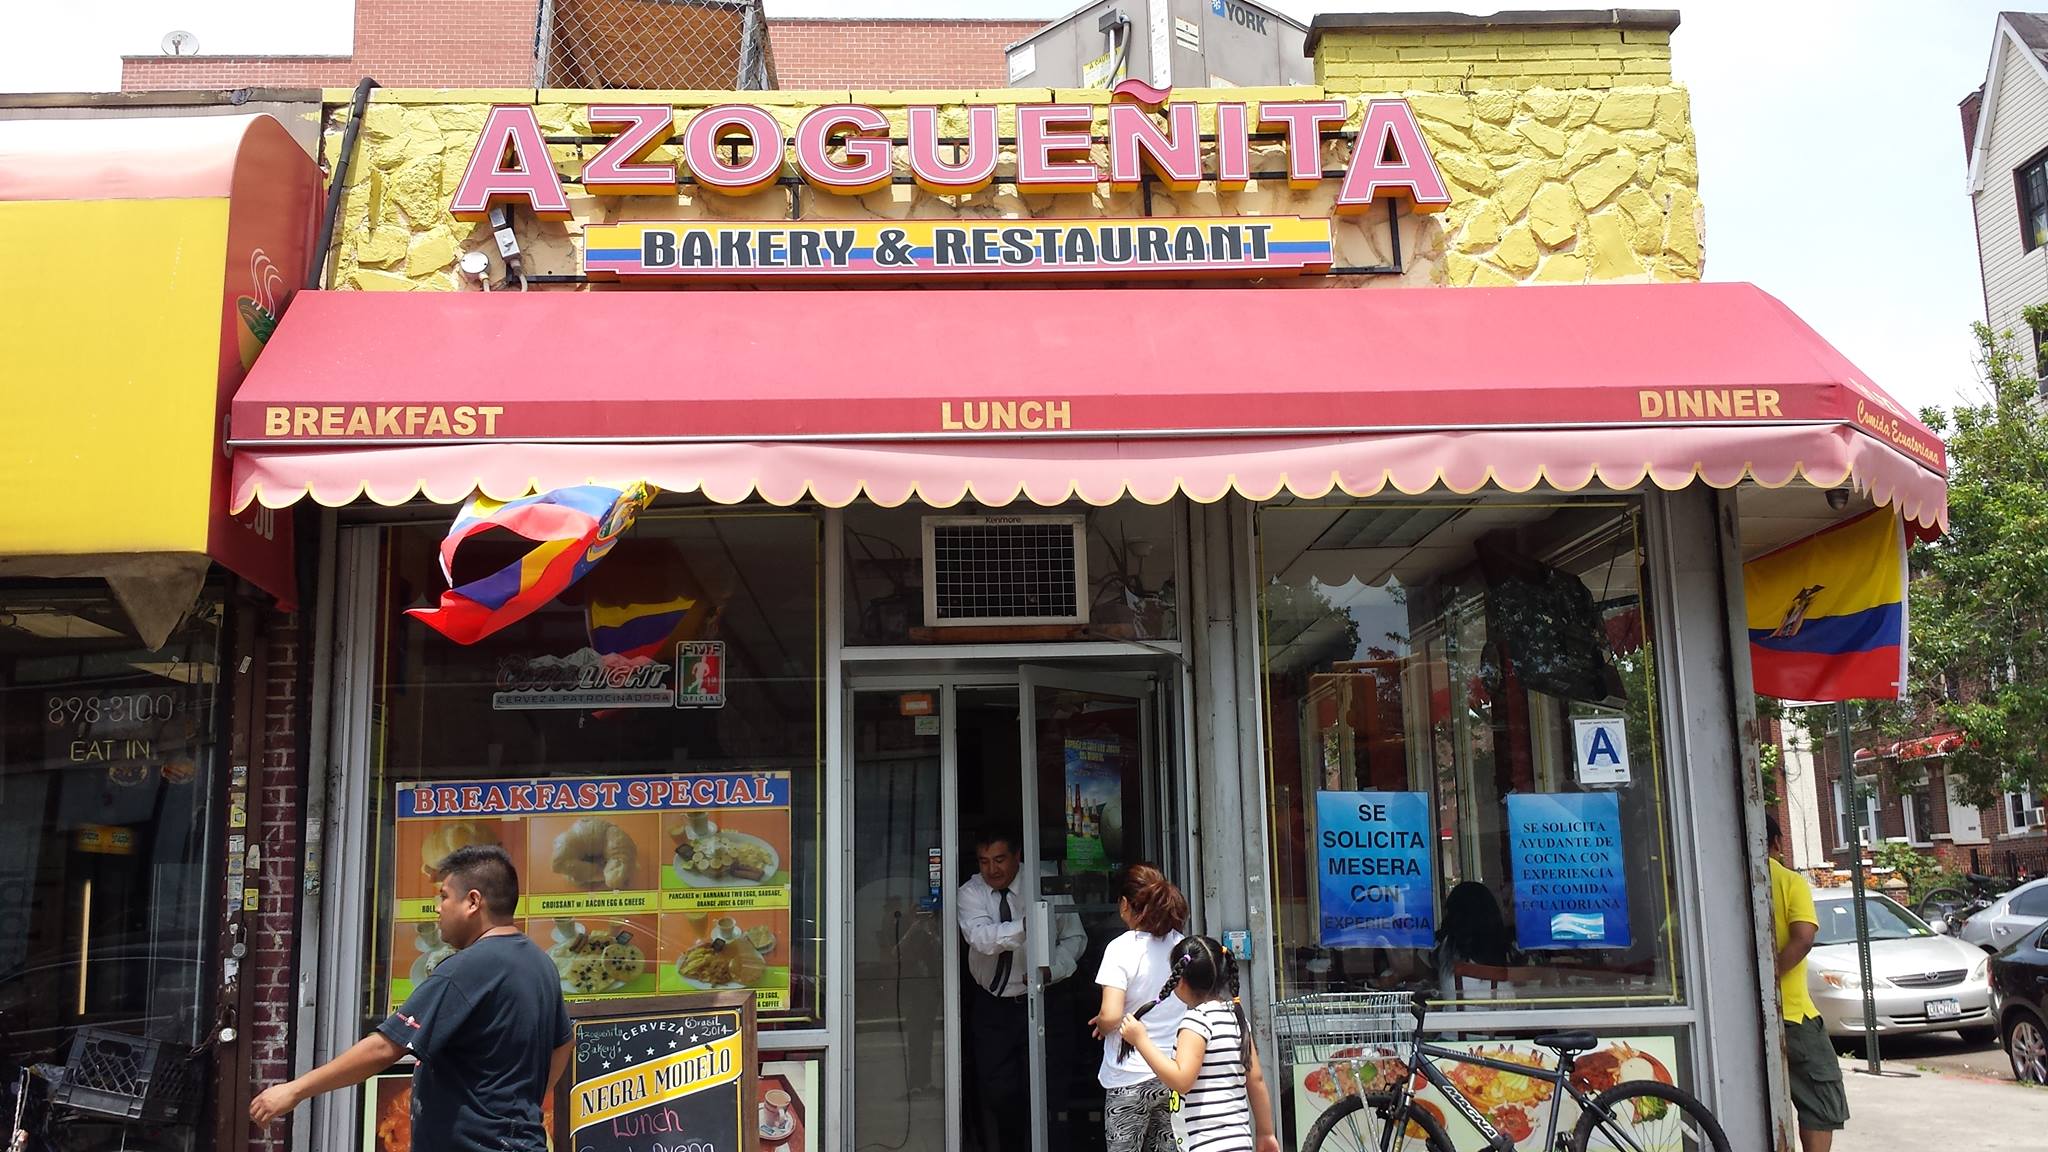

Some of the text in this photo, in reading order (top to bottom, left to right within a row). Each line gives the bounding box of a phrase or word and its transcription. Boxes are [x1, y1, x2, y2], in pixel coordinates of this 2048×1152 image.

[1225, 1, 1267, 35] YORK
[450, 79, 1452, 216] AZOGUEÑITA
[641, 225, 1272, 269] BAKERY & RESTAURANT
[265, 389, 1783, 436] BREAKFAST LUNCH DINNER
[1857, 399, 1940, 465] Comida Ecuatoriana
[985, 516, 1022, 524] Kenmore
[579, 663, 672, 688] LIGHT
[682, 695, 721, 703] OFICIAL
[49, 694, 173, 724] 898-3100
[71, 740, 151, 761] EAT IN
[1587, 727, 1620, 765] A
[413, 777, 775, 815] BREAKFAST SPECIAL
[1358, 804, 1387, 822] SE
[1523, 822, 1606, 833] SE SOLICITA
[1323, 831, 1425, 848] SOLICITA
[1519, 836, 1614, 849] AYUDANTE DE
[1328, 858, 1421, 876] MESERA
[1524, 852, 1609, 864] COCINA CON
[1523, 868, 1614, 880] EXPERIENCIA
[1350, 884, 1399, 903] CON
[1531, 883, 1608, 895] EN COMIDA
[542, 900, 575, 909] CROISSANT
[585, 898, 606, 908] BACON
[606, 898, 618, 907] EGG
[624, 897, 645, 906] CHEESE
[1522, 898, 1620, 911] ECUATORIANA
[1325, 916, 1431, 930] EXPERIENCIA
[762, 1000, 780, 1008] COFFEE
[622, 1021, 684, 1041] CERVEZA
[701, 1024, 733, 1037] 2014
[580, 1047, 731, 1118] NEGRA MODELO
[1443, 1086, 1498, 1139] MAGNA
[612, 1106, 684, 1138] Lunch
